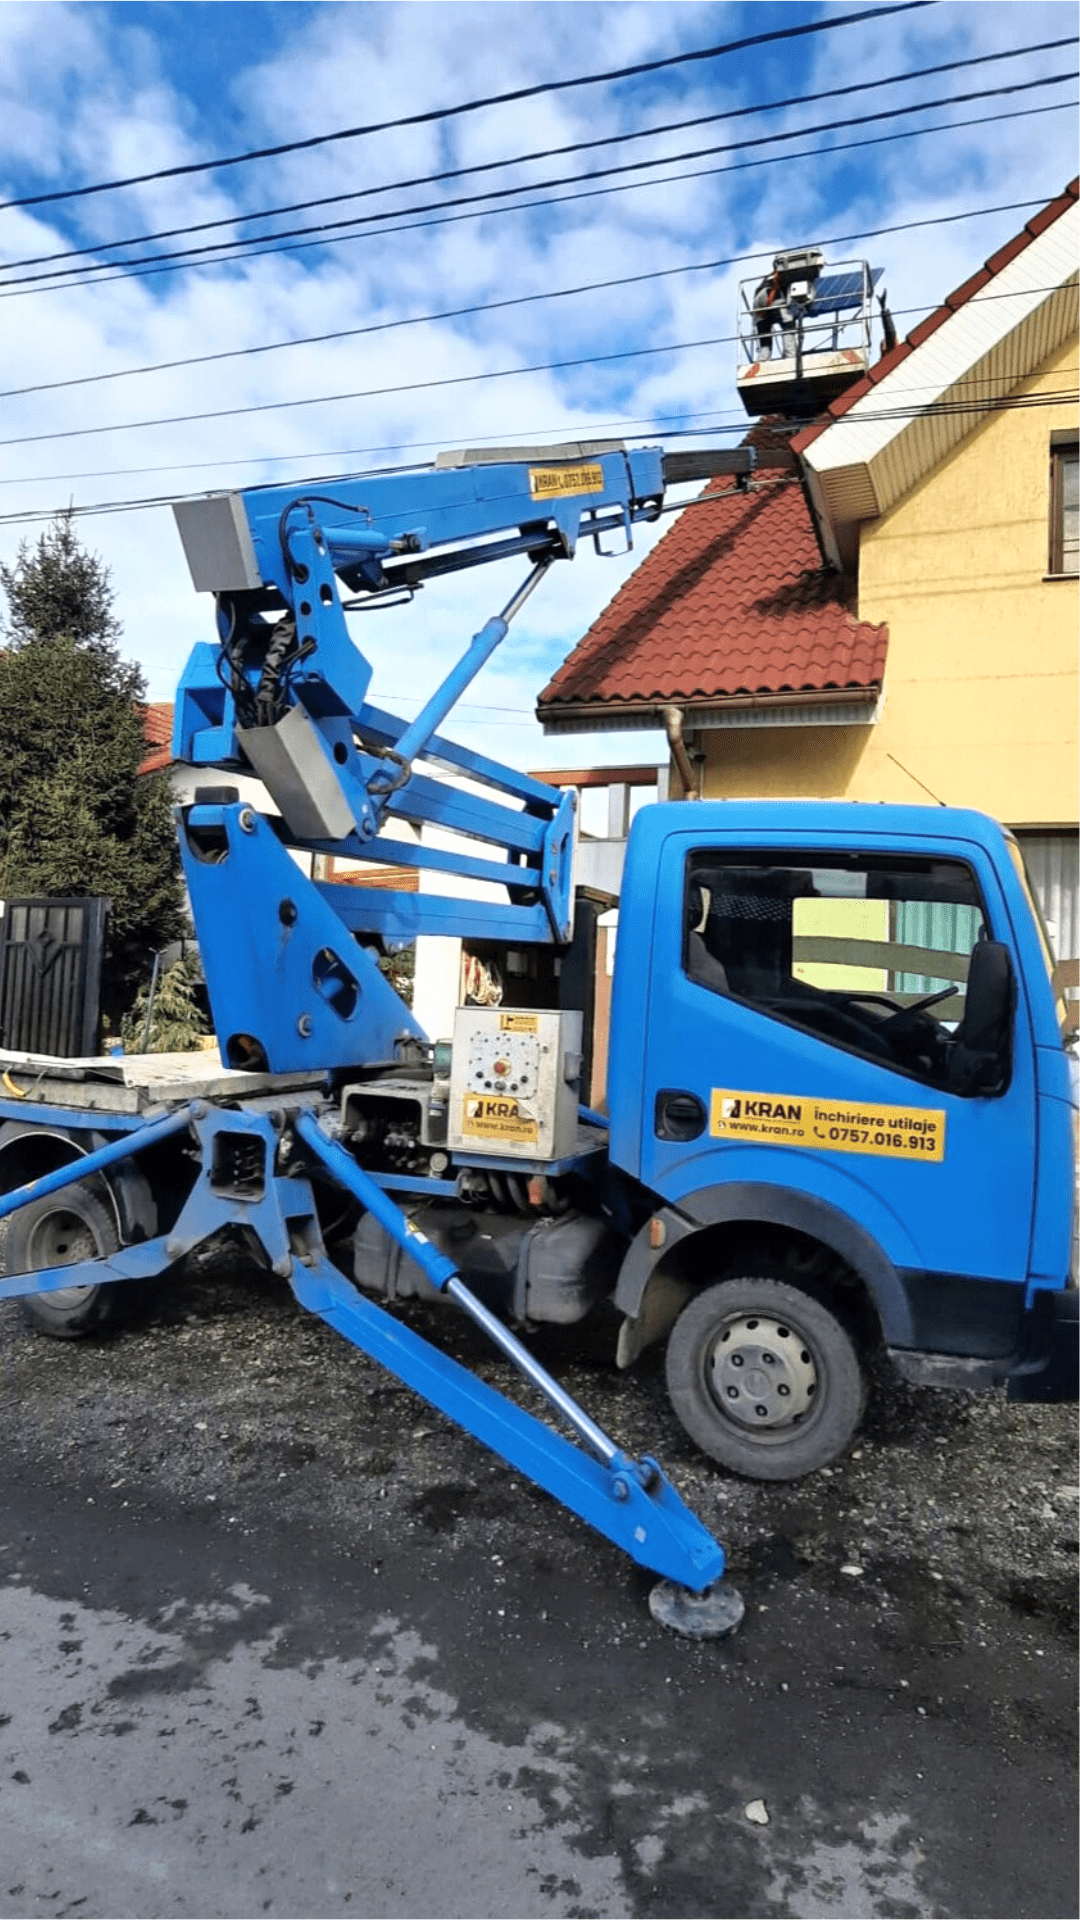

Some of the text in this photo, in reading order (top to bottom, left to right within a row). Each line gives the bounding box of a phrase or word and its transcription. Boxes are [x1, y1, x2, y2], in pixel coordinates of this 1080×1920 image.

[486, 1102, 519, 1118] KRA
[745, 1100, 801, 1120] KRAN
[476, 1122, 533, 1134] www.kran.ro
[729, 1122, 805, 1137] www.kran.ro
[888, 1117, 936, 1135] utilaje
[829, 1127, 936, 1151] 0757.016.913
